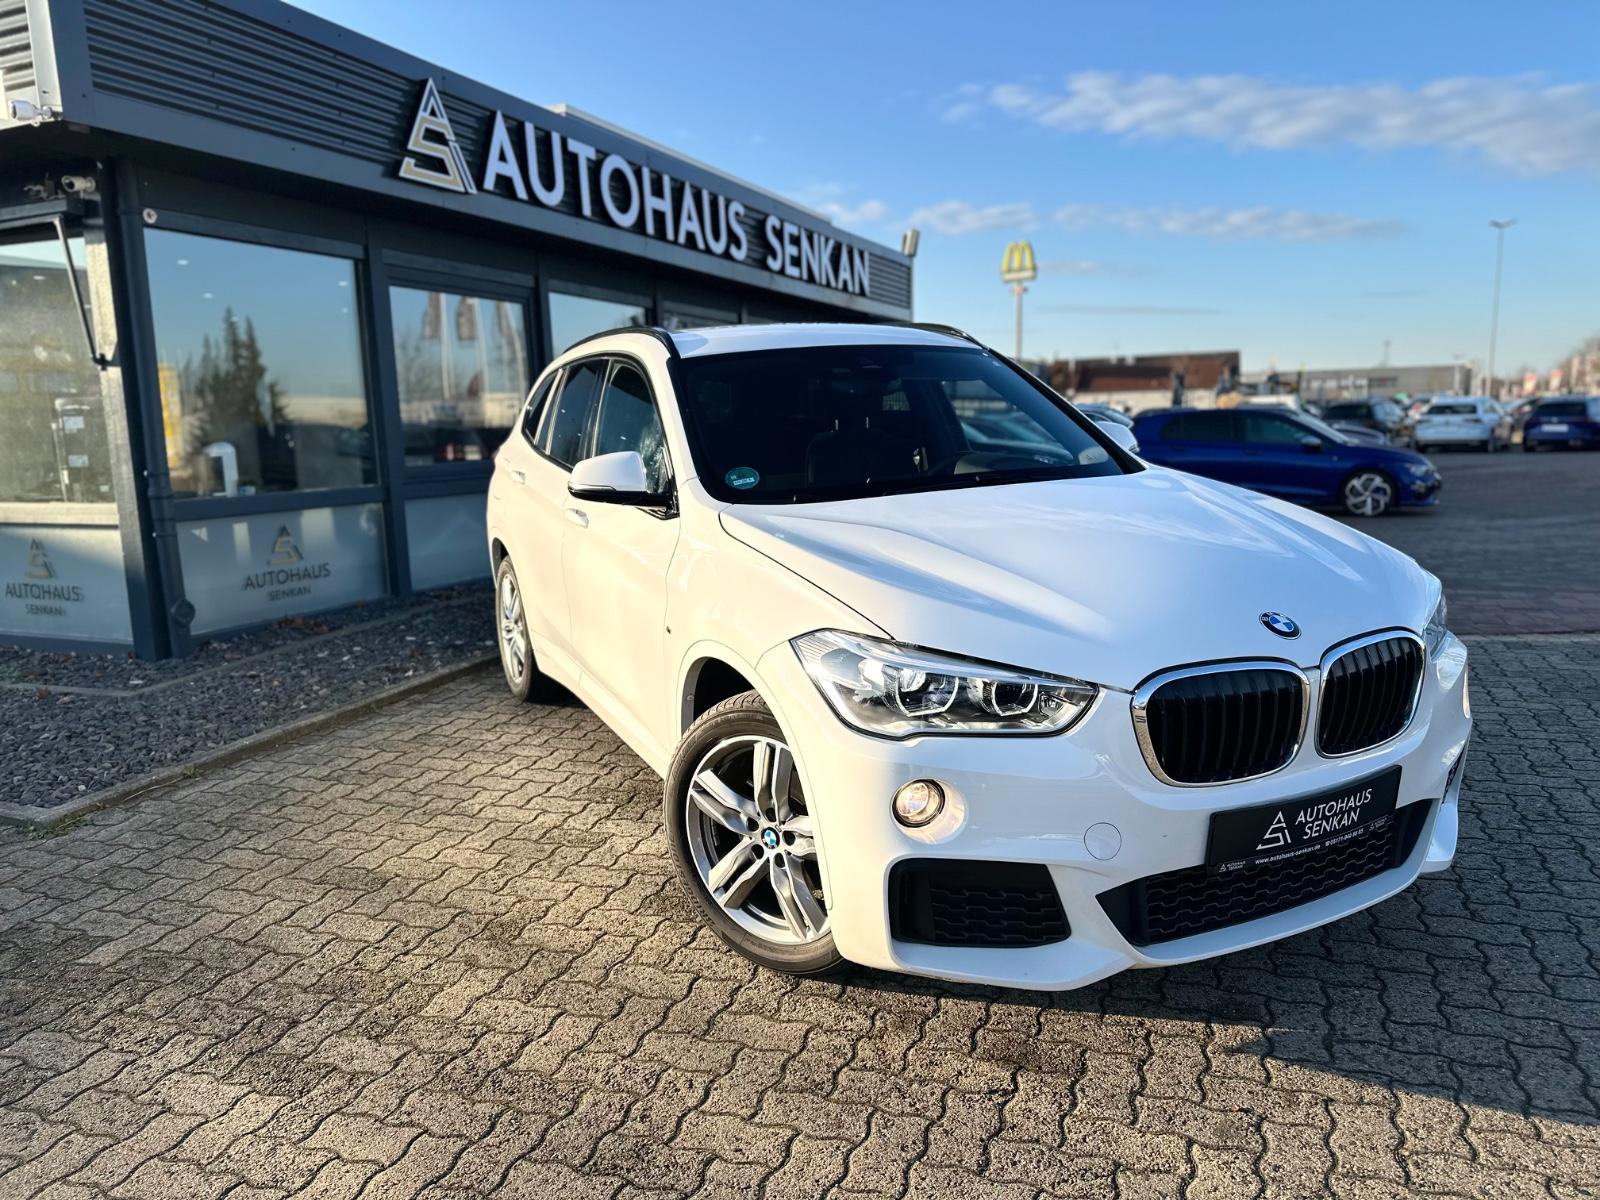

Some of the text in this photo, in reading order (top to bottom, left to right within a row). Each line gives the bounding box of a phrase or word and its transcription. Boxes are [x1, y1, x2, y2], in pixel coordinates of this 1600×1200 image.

[483, 110, 747, 262] AUTOHAUS
[765, 214, 870, 296] SENKAN
[243, 562, 331, 591] AUTOHAUS
[5, 582, 84, 602] AUTOHAUS
[268, 584, 312, 601] SENKAN
[25, 603, 65, 616] SENKAN
[1295, 788, 1373, 825] AUTOHAUS
[1303, 808, 1360, 839] SENKAN
